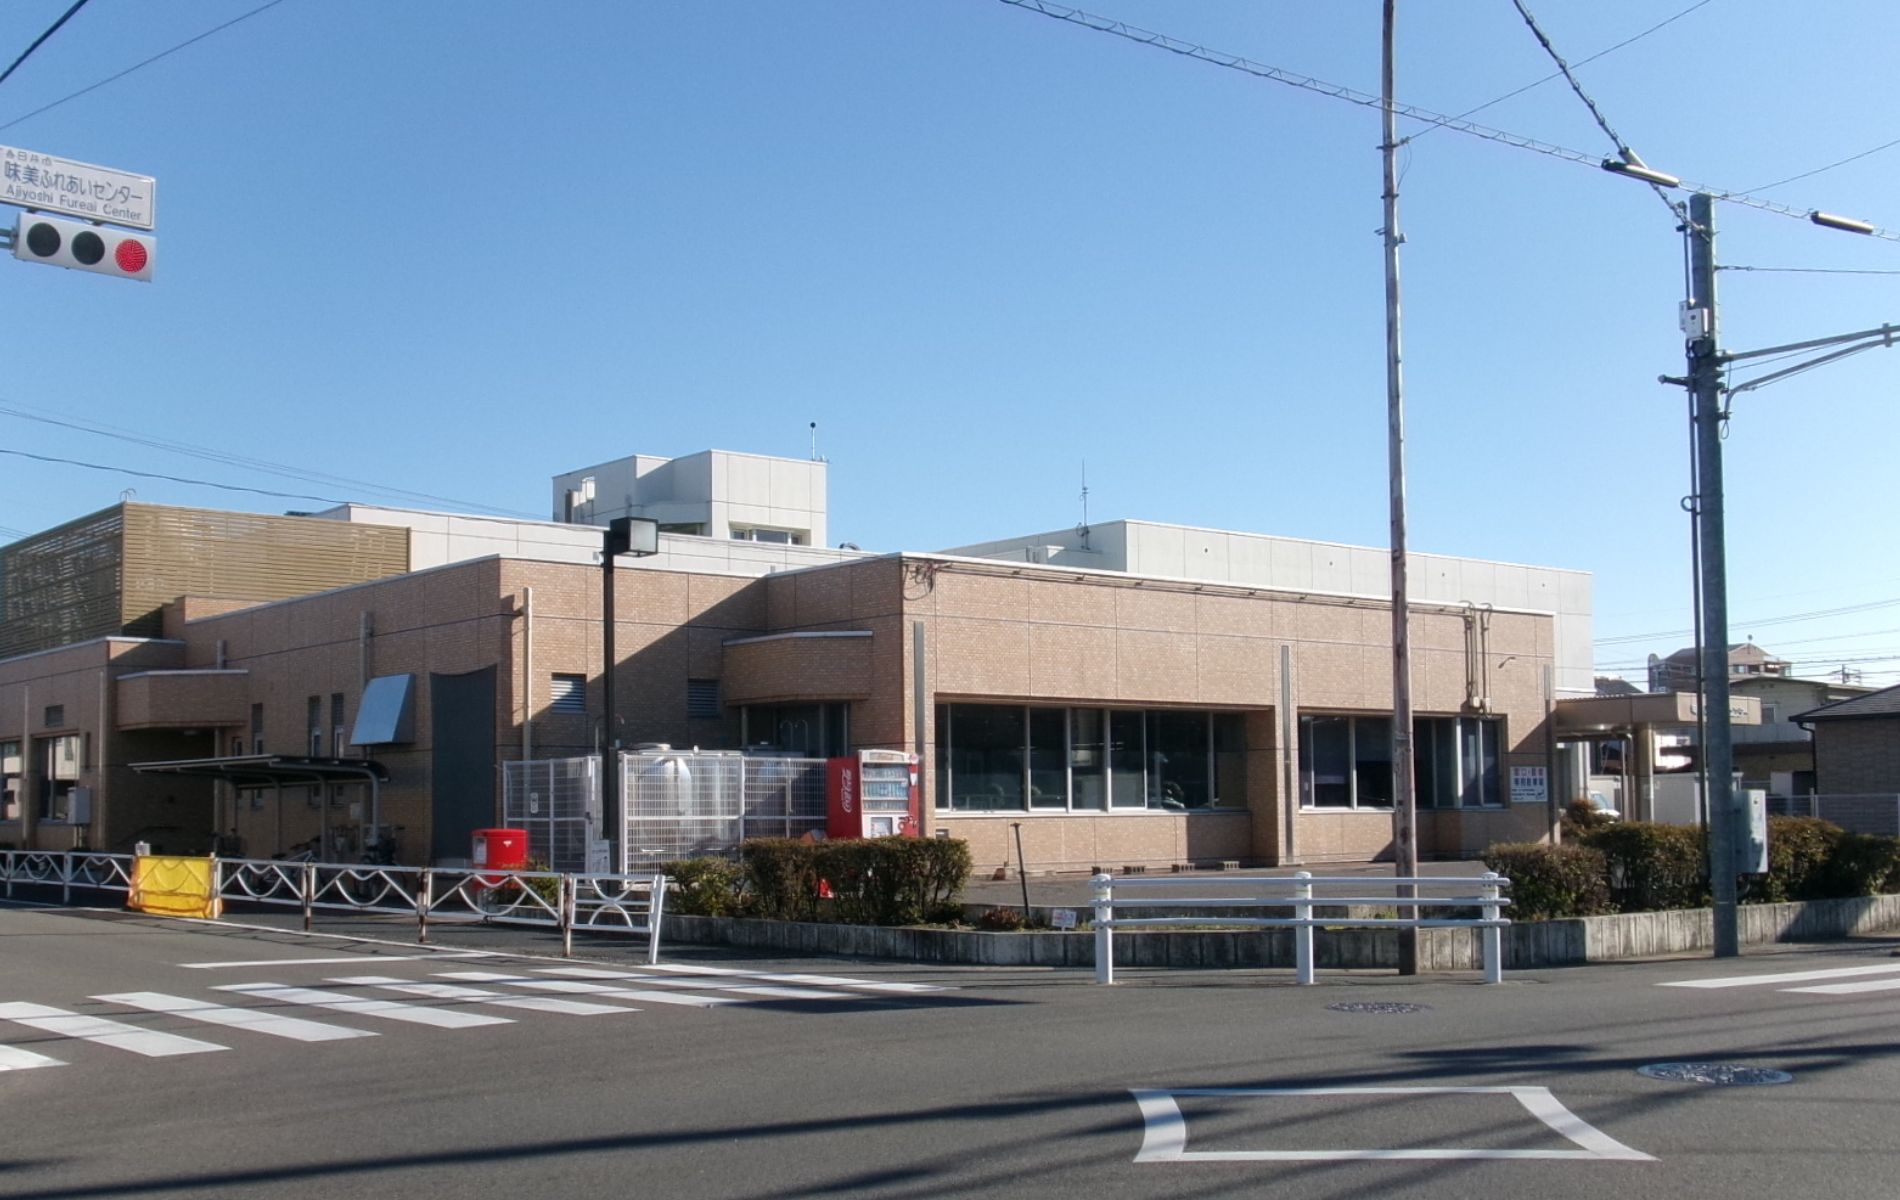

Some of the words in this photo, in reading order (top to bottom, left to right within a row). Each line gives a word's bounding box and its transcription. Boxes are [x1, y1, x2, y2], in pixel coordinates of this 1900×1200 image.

[4, 160, 143, 204] 味美ふれあいセンター
[6, 184, 54, 204] Ajiyoshi
[59, 194, 97, 213] Fureai
[103, 203, 142, 221] Center
